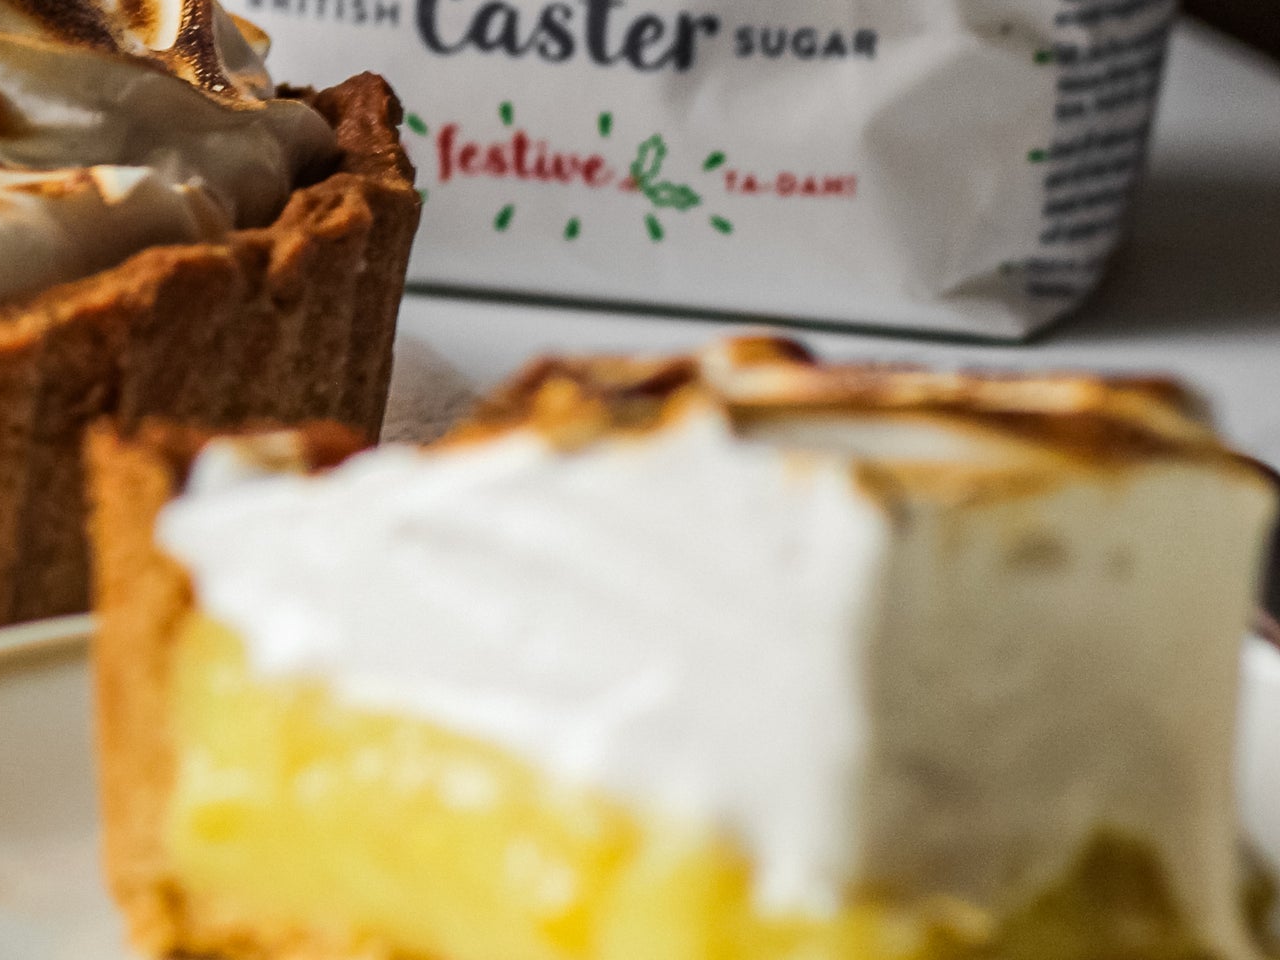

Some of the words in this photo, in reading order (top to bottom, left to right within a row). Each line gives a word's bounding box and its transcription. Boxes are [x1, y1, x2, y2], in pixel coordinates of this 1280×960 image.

[733, 24, 880, 61] SUGAR
[436, 123, 615, 191] festive
[724, 170, 859, 200] TA-DAH!
